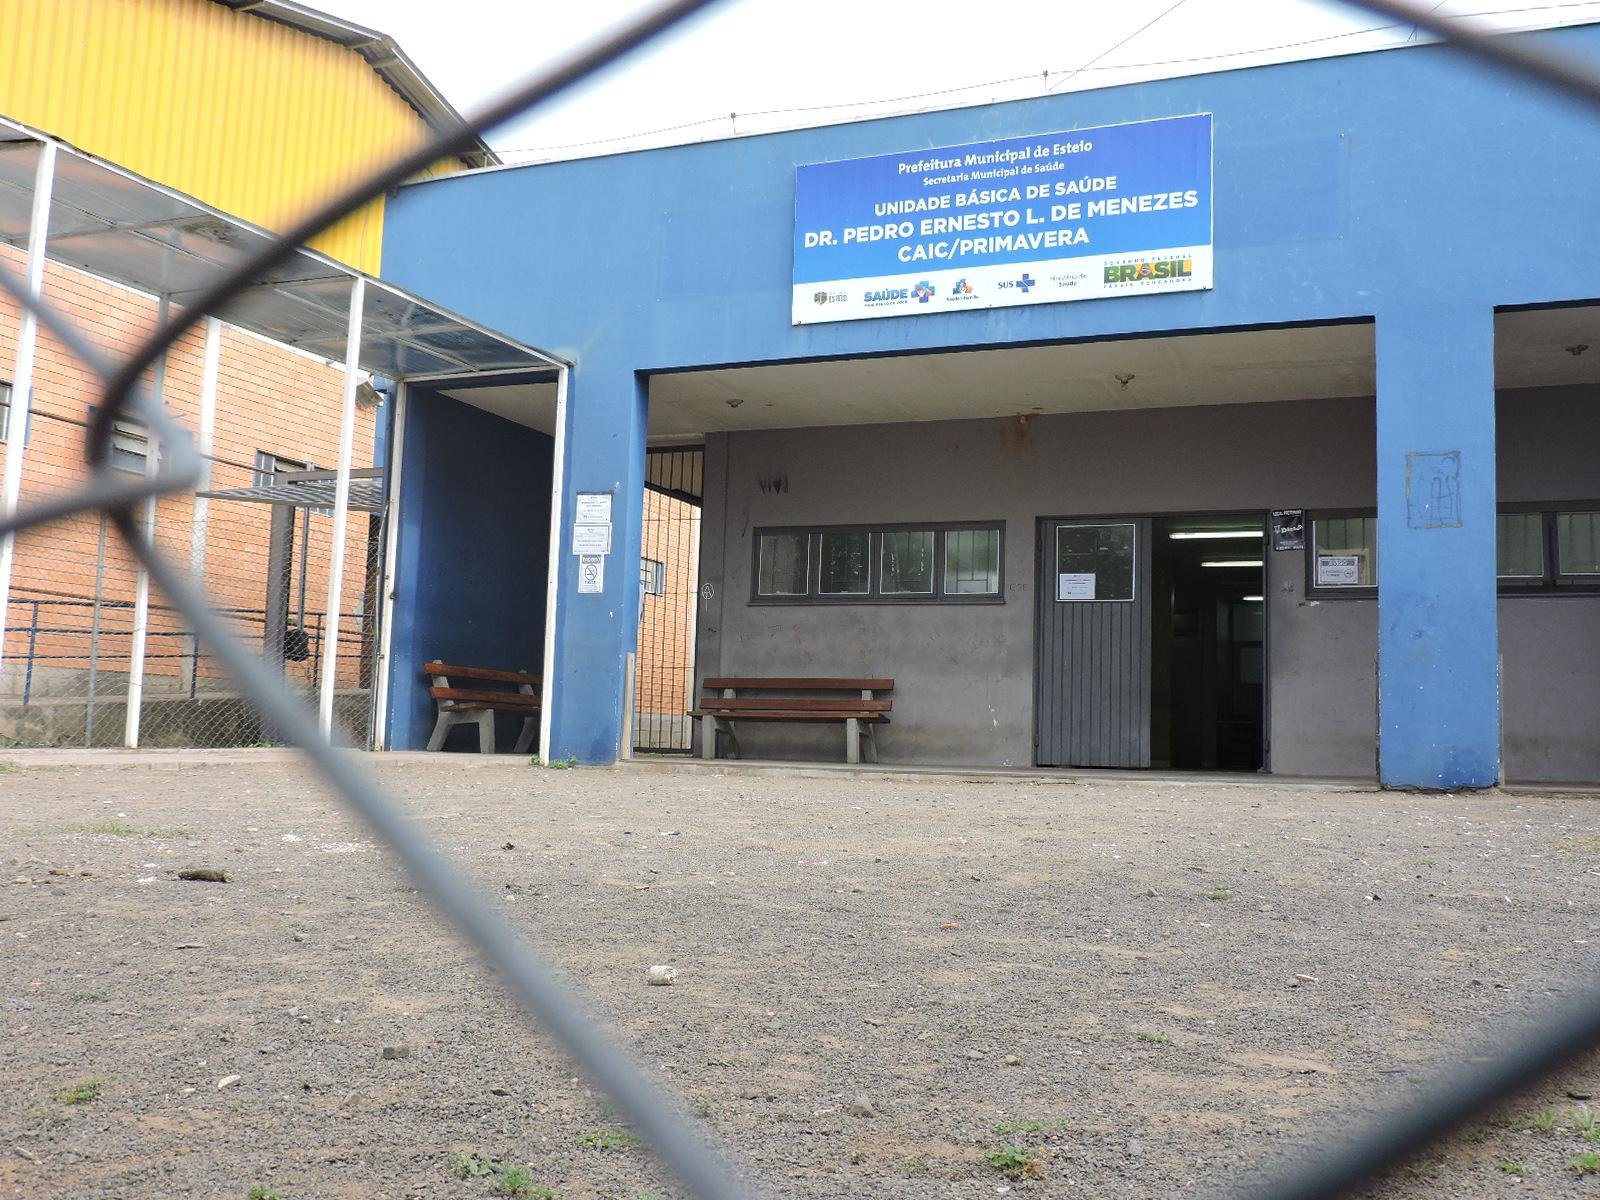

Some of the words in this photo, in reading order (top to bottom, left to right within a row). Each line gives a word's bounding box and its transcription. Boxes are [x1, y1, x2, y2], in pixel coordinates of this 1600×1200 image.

[898, 159, 962, 174] Prefeitura
[965, 148, 1031, 166] Municipal
[1034, 145, 1050, 158] de
[1053, 140, 1092, 155] Esteio
[923, 174, 969, 186] Secretaria
[971, 166, 1019, 181] Municipal
[1021, 165, 1033, 175] de
[1034, 161, 1065, 172] Saúde
[874, 194, 951, 216] UNIDADE
[955, 187, 1021, 208] BÁSICA
[1026, 184, 1051, 199] DE
[1055, 175, 1117, 196] SAÚDE
[804, 230, 838, 248] DR.
[843, 221, 915, 244] PEDRO
[920, 209, 1021, 236] ERNESTO
[1026, 208, 1045, 225] L.
[1051, 203, 1082, 222] DE
[1087, 190, 1199, 218] MENEZES
[897, 227, 1090, 262] CAIC/PRIMAVERA
[998, 280, 1014, 289] SUS
[1104, 260, 1192, 284] BRASIL
[864, 288, 908, 301] SAÚDE
